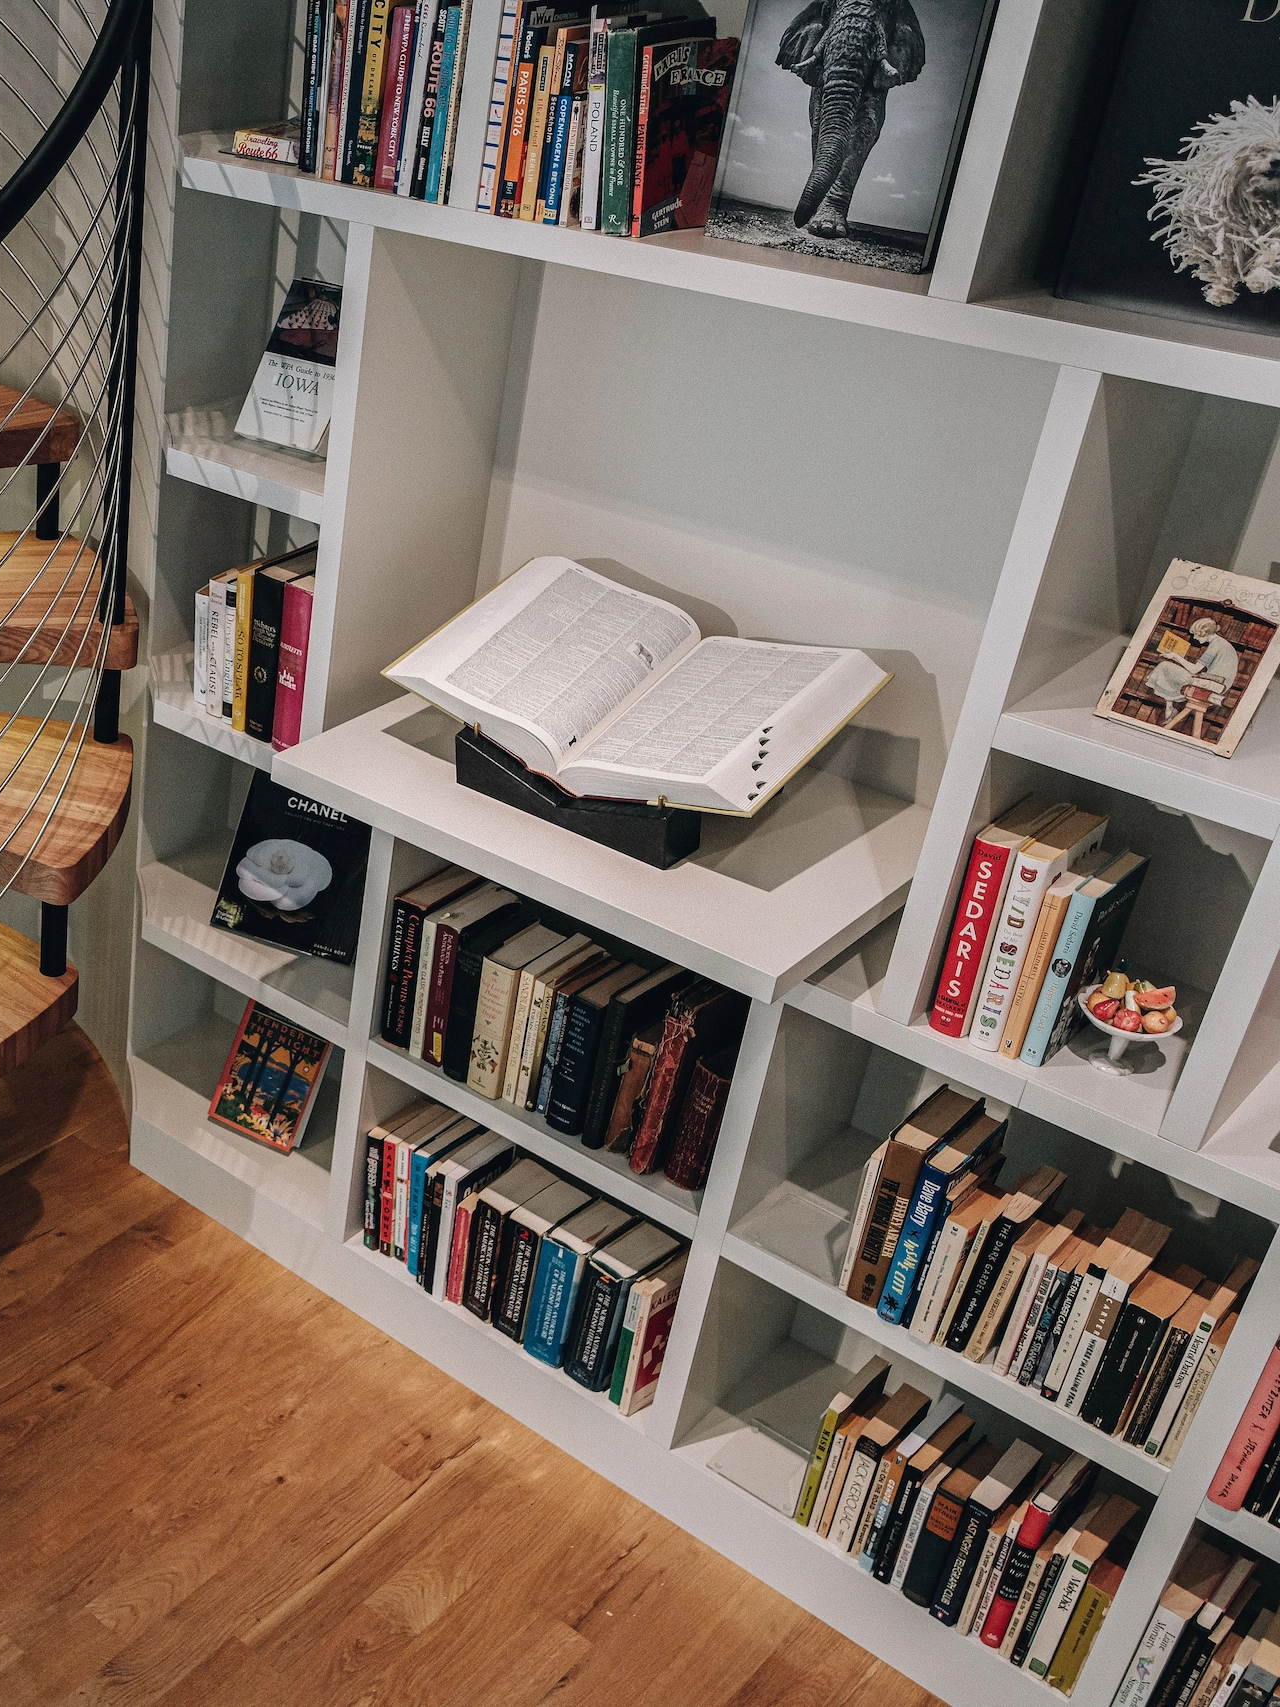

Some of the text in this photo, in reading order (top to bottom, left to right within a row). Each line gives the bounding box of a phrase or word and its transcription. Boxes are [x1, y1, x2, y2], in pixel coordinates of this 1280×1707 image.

[402, 15, 411, 31] THE
[438, 10, 447, 32] SCOTT
[366, 0, 386, 101] CITY OF DREAMS
[524, 31, 534, 59] Fodor's
[398, 54, 406, 82] GUIDE
[428, 42, 445, 92] ROUTE
[563, 54, 574, 86] MOON
[655, 48, 691, 79] PARIS
[672, 69, 726, 87] FRANCE
[310, 76, 315, 85] TO
[395, 82, 403, 94] TO
[424, 98, 436, 117] 66
[510, 71, 529, 136] PARIS 2016
[547, 97, 557, 143] Stockholm
[554, 99, 567, 161] COPENHAGEN
[590, 102, 601, 152] POLAND
[237, 143, 278, 160] Route 66
[243, 133, 279, 149] Traveling
[388, 140, 396, 158] CITY
[421, 126, 430, 147] KELLY
[631, 123, 644, 189] PARIS FRANCE
[548, 171, 558, 205] BEYOND
[268, 359, 279, 368] The
[281, 361, 294, 371] WPA
[295, 365, 314, 376] Guide
[314, 370, 321, 378] to
[275, 373, 320, 396] IOWA
[211, 611, 219, 639] REBEL
[222, 612, 235, 696] Dreyer's English
[232, 630, 245, 698] SO TO SPEAK
[209, 657, 217, 694] CLAUSE
[287, 796, 348, 823] CHANEL
[977, 849, 1002, 862] David
[1007, 864, 1039, 929] DAVID
[392, 920, 403, 970] CUMMINGS
[946, 861, 993, 998] SEDARIS
[400, 915, 419, 1002] Complete Poems
[1036, 911, 1084, 1034] David Sedaris Happy-Go-Lucky
[979, 941, 1018, 1030] SEDARIS
[249, 1022, 320, 1058] THE NIGHT
[257, 1014, 319, 1047] TENDER IS
[383, 1145, 393, 1191] PAPER
[383, 1200, 391, 1239] TOWNS
[910, 1179, 942, 1228] Dave Barry
[520, 1227, 530, 1241] 2
[882, 1197, 908, 1257] JEFFREY ARCHER
[891, 1238, 919, 1296] INSANE CITY
[955, 1223, 1012, 1333] THE DARK GARDEN eden bradley
[1053, 1275, 1081, 1335] THE FALL ALBERT CAMUS
[1094, 1298, 1113, 1336] CARVER
[1024, 1306, 1054, 1371] CAMUS THE STRANGER
[1084, 1340, 1096, 1359] WHERE
[1192, 1334, 1205, 1354] Heart
[1071, 1368, 1085, 1392] CALLING
[1173, 1358, 1194, 1389] Darkness
[1065, 1392, 1075, 1408] FROM
[1218, 1437, 1259, 1498] STEPHANIE DANLER
[839, 1453, 870, 1530] JACK KEROUAC
[886, 1478, 896, 1505] GENDER
[873, 1506, 886, 1528] QUEER
[938, 1501, 957, 1515] MAIN
[939, 1518, 979, 1604] LAST NIGHT TELEGRAPH CLUB
[1010, 1557, 1031, 1570] Paris
[1017, 1548, 1032, 1560] The
[1009, 1566, 1026, 1580] Wife
[1057, 1574, 1082, 1612] Moby-Dick
[1145, 1619, 1167, 1650] Moriarty
[1159, 1631, 1176, 1651] Liane
